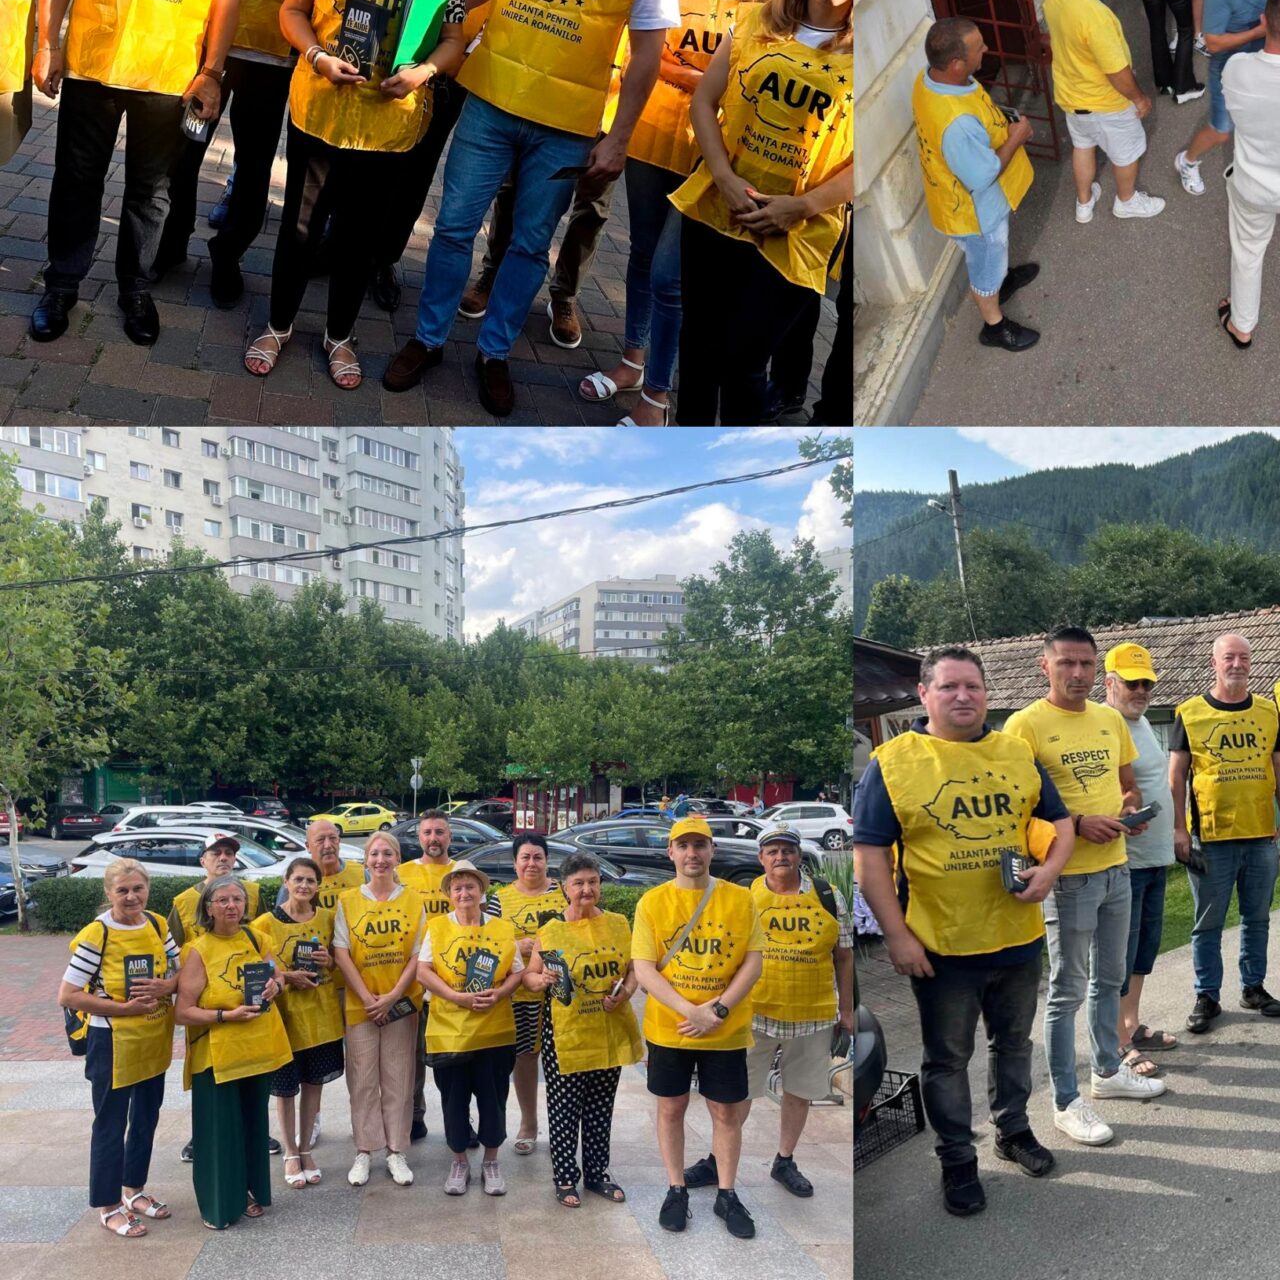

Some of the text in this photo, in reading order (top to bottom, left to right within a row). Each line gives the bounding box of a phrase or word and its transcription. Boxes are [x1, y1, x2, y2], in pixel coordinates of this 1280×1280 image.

[347, 7, 371, 26] AUR
[546, 12, 580, 31] PENTRU
[501, 8, 583, 44] UNIREA ROMÂNILOR
[679, 28, 723, 55] AU
[757, 66, 832, 122] AUR
[1220, 733, 1257, 750] AUR
[1061, 749, 1110, 765] RESPECT
[951, 793, 1014, 820] AUR
[944, 861, 981, 872] UNIREA
[364, 920, 402, 936] AUR
[769, 917, 811, 932] AUR
[298, 945, 312, 954] AUR
[680, 936, 722, 955] AUR
[129, 959, 148, 970] AUR
[476, 954, 494, 966] AUR
[582, 961, 620, 980] AUR
